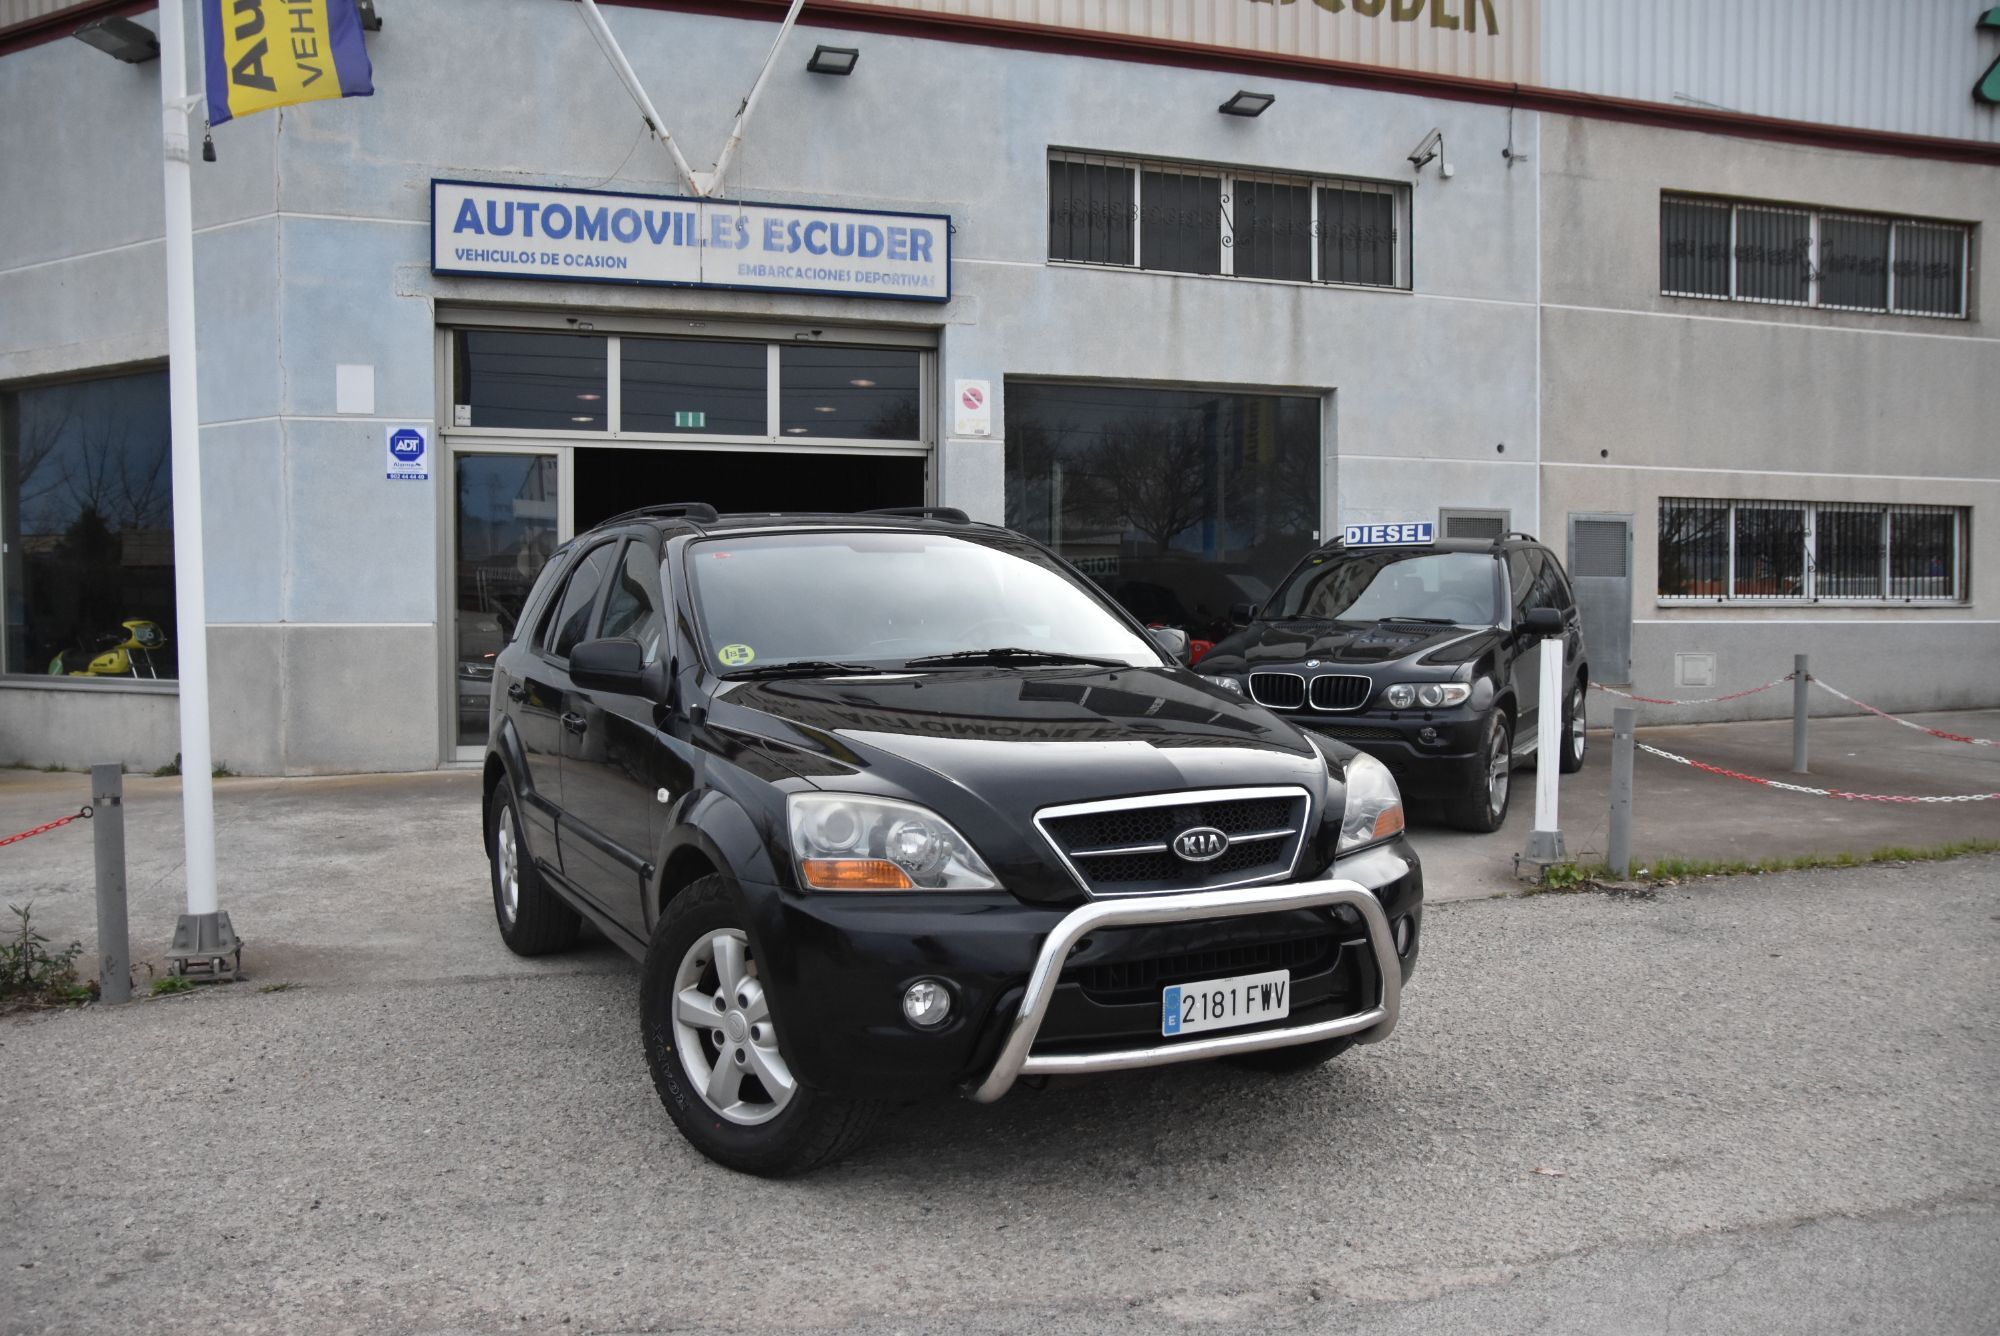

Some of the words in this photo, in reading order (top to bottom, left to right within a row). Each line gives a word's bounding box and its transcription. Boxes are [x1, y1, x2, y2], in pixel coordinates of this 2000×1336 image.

[453, 198, 749, 250] AUTOMOVILES
[762, 217, 934, 263] ESCUDER
[455, 248, 536, 265] VEHICULOS
[540, 253, 560, 266] DE
[563, 253, 628, 269] OCASION
[737, 263, 851, 283] EMBARCACIONES
[855, 271, 935, 289] DEPORTIVAS
[396, 439, 419, 452] ADT
[1346, 524, 1431, 544] DIESEL
[1182, 834, 1220, 855] KIA
[1168, 1014, 1176, 1026] E
[1182, 988, 1237, 1024] 2181
[1247, 980, 1286, 1014] FWV
